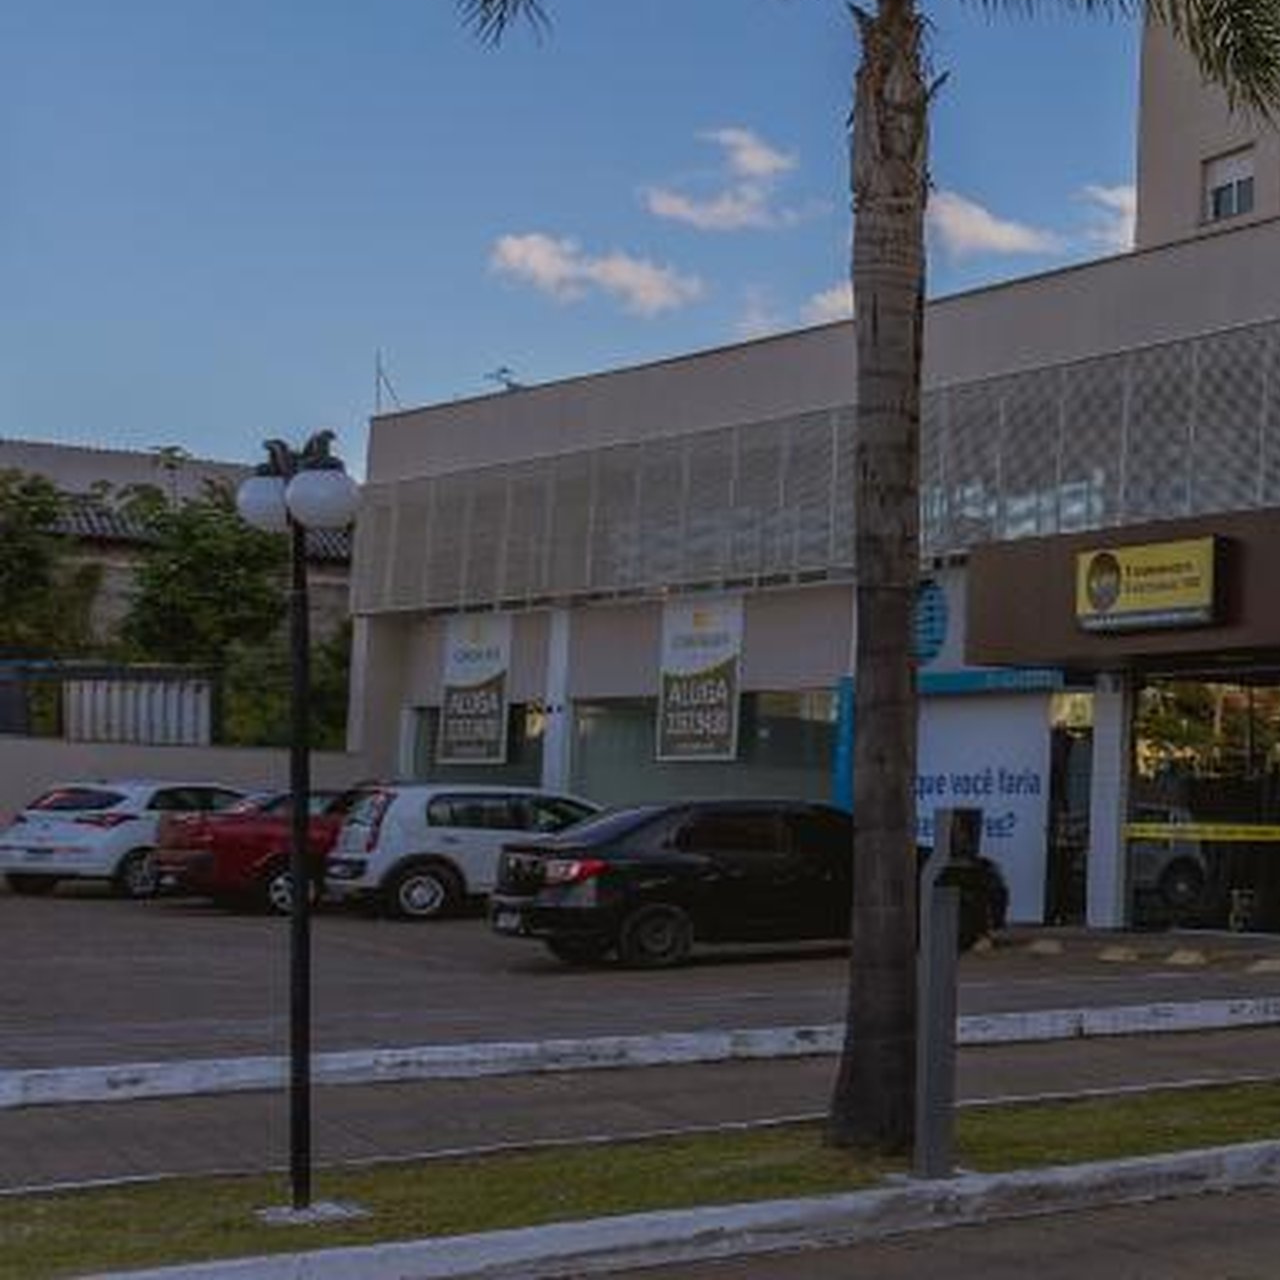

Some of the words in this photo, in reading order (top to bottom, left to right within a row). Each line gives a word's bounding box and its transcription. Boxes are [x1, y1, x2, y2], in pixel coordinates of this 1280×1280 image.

[666, 679, 727, 709] ALUGA
[950, 767, 993, 795] você
[998, 767, 1041, 795] faria
